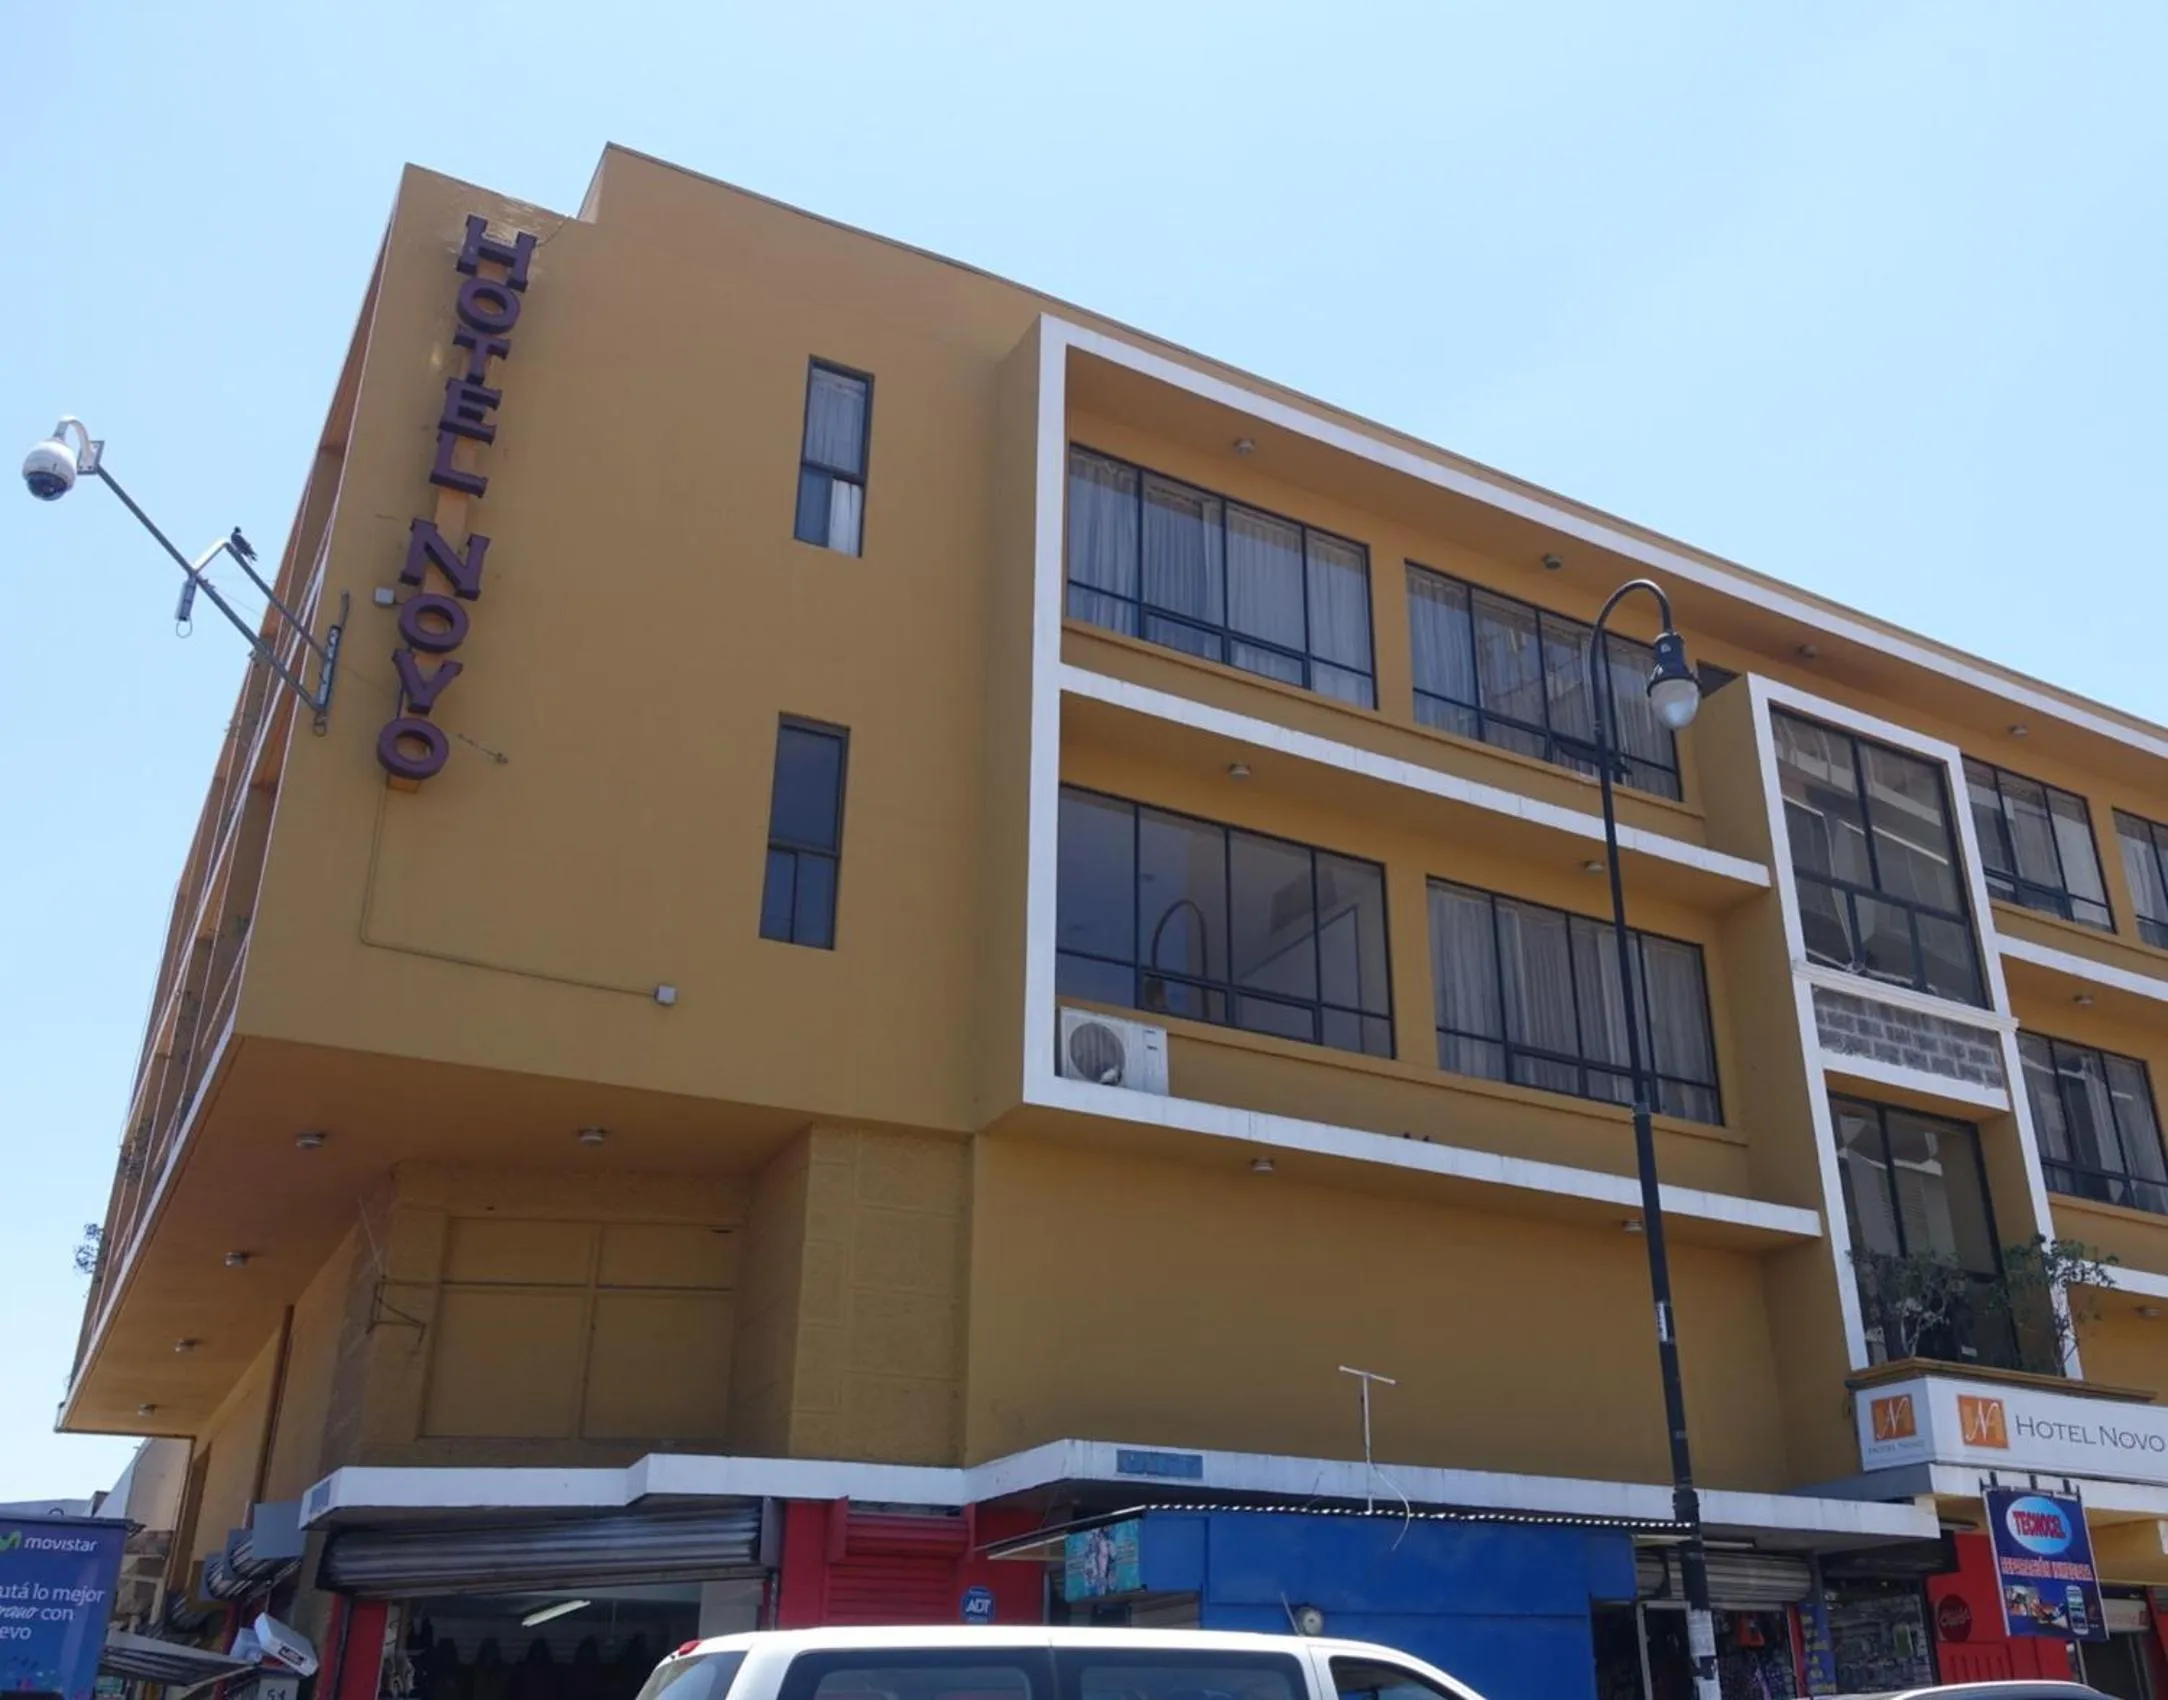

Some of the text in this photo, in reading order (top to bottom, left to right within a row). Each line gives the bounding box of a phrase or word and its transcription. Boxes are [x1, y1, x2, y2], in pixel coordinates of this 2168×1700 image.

[376, 214, 538, 780] HOTEL NOVO
[2015, 1414, 2165, 1452] HOTEL NOVO
[24, 1536, 98, 1553] movistar
[33, 1583, 49, 1600] lo
[52, 1586, 105, 1607] mejor
[41, 1607, 73, 1621] con
[966, 1598, 991, 1614] ADT
